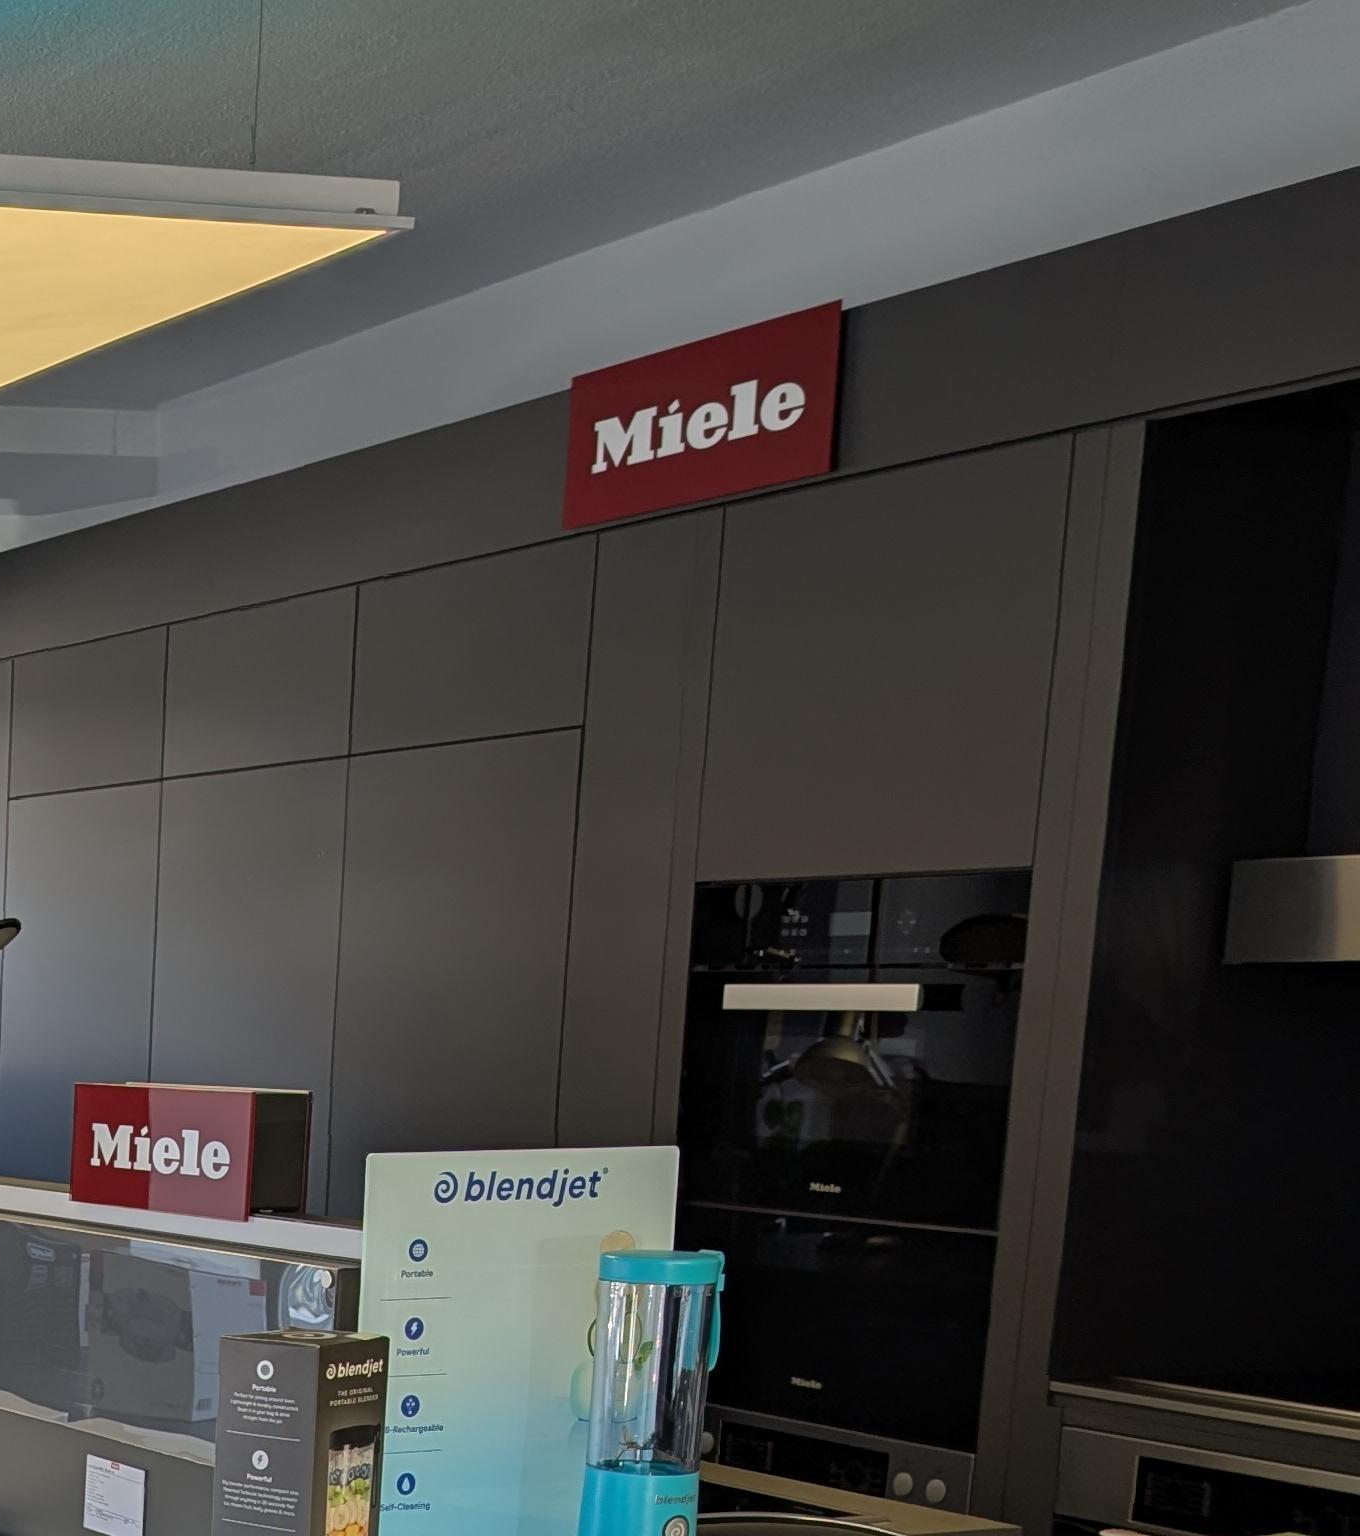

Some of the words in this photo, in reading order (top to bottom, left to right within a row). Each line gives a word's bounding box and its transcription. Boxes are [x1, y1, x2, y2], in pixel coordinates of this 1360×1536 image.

[591, 379, 806, 475] Miele
[90, 1122, 230, 1180] Miele
[810, 1182, 841, 1194] Miele
[401, 1270, 434, 1279] Portable
[397, 1348, 430, 1356] Powerful
[338, 1359, 384, 1379] blendjet
[791, 1376, 823, 1390] Miele
[330, 1397, 357, 1407] PORTABLE
[385, 1424, 444, 1434] B-Rechargeable
[380, 1502, 431, 1512] Self-Cleaning
